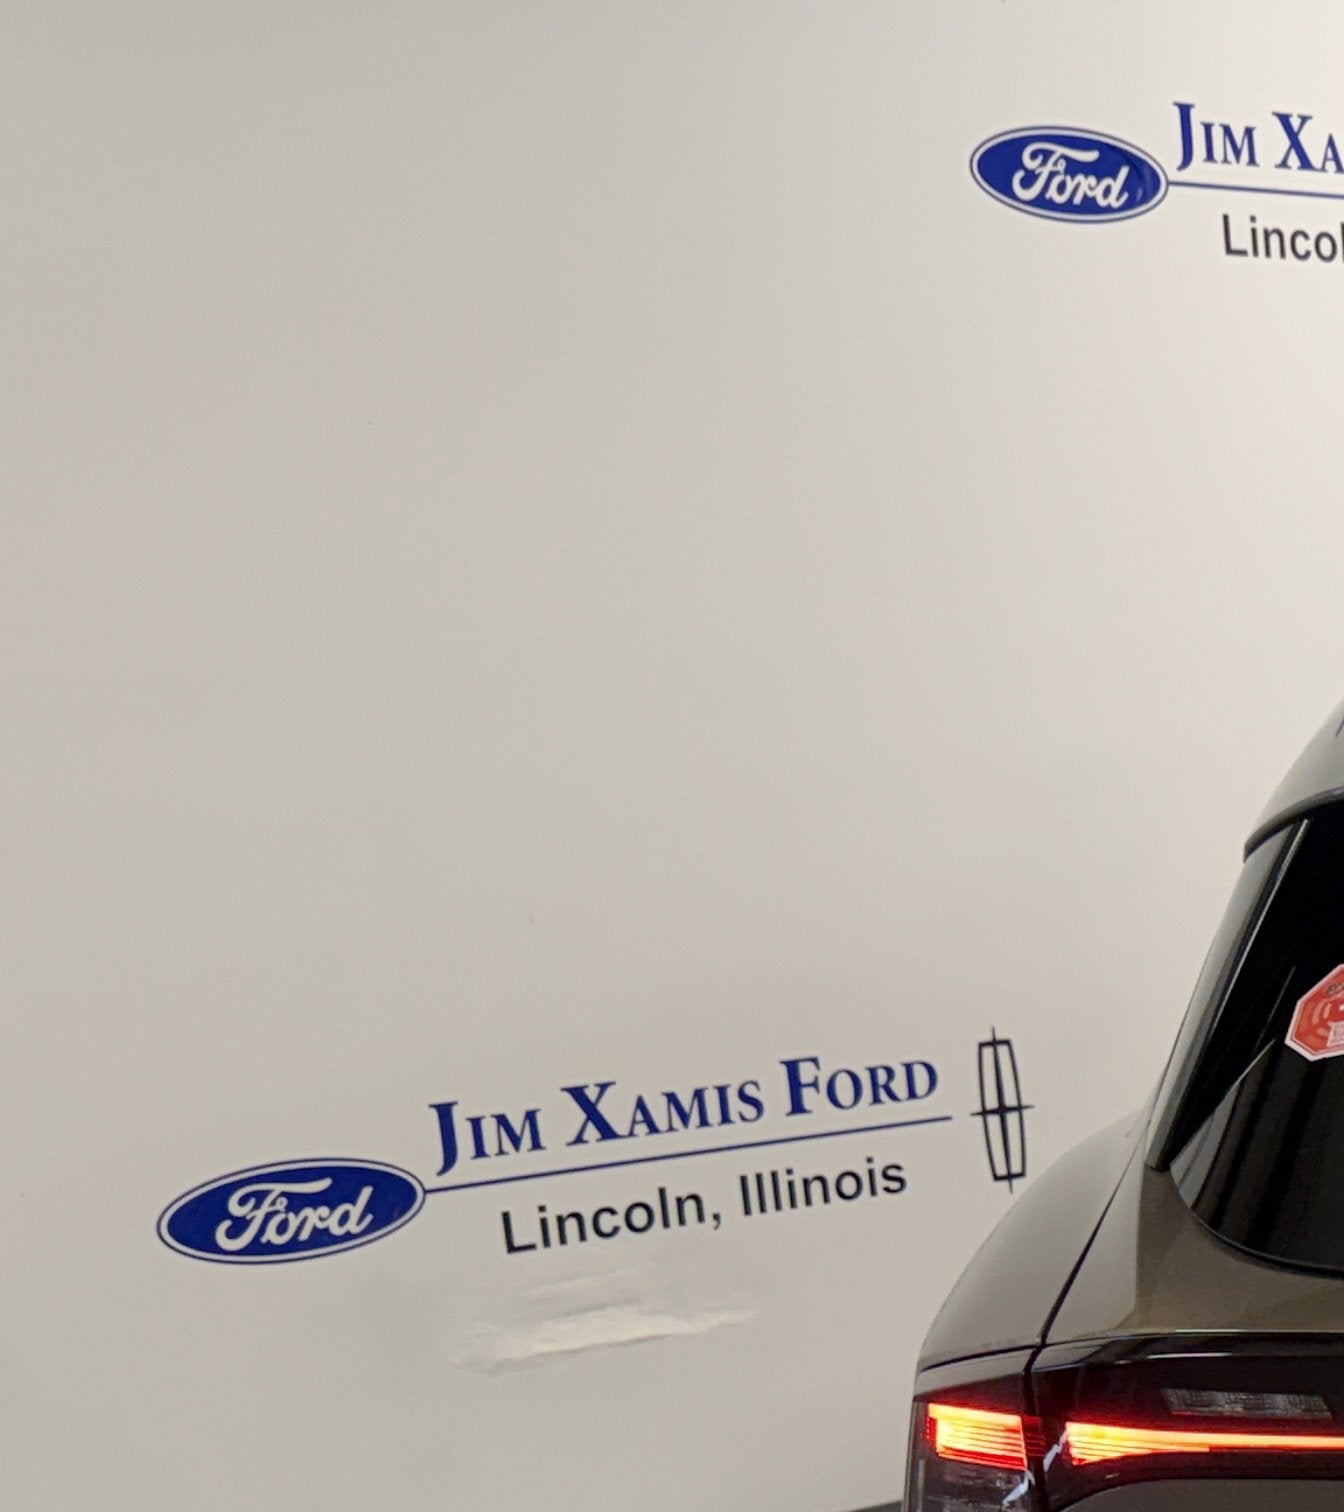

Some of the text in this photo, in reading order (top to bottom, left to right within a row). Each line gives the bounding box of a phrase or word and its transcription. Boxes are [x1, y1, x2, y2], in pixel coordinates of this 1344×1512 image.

[1011, 141, 1130, 208] Ford
[1172, 101, 1258, 172] JIM
[427, 1055, 939, 1178] JIM XAMIS FORD
[213, 1176, 374, 1252] Ford
[500, 1155, 908, 1256] Lincoln, Illinois
